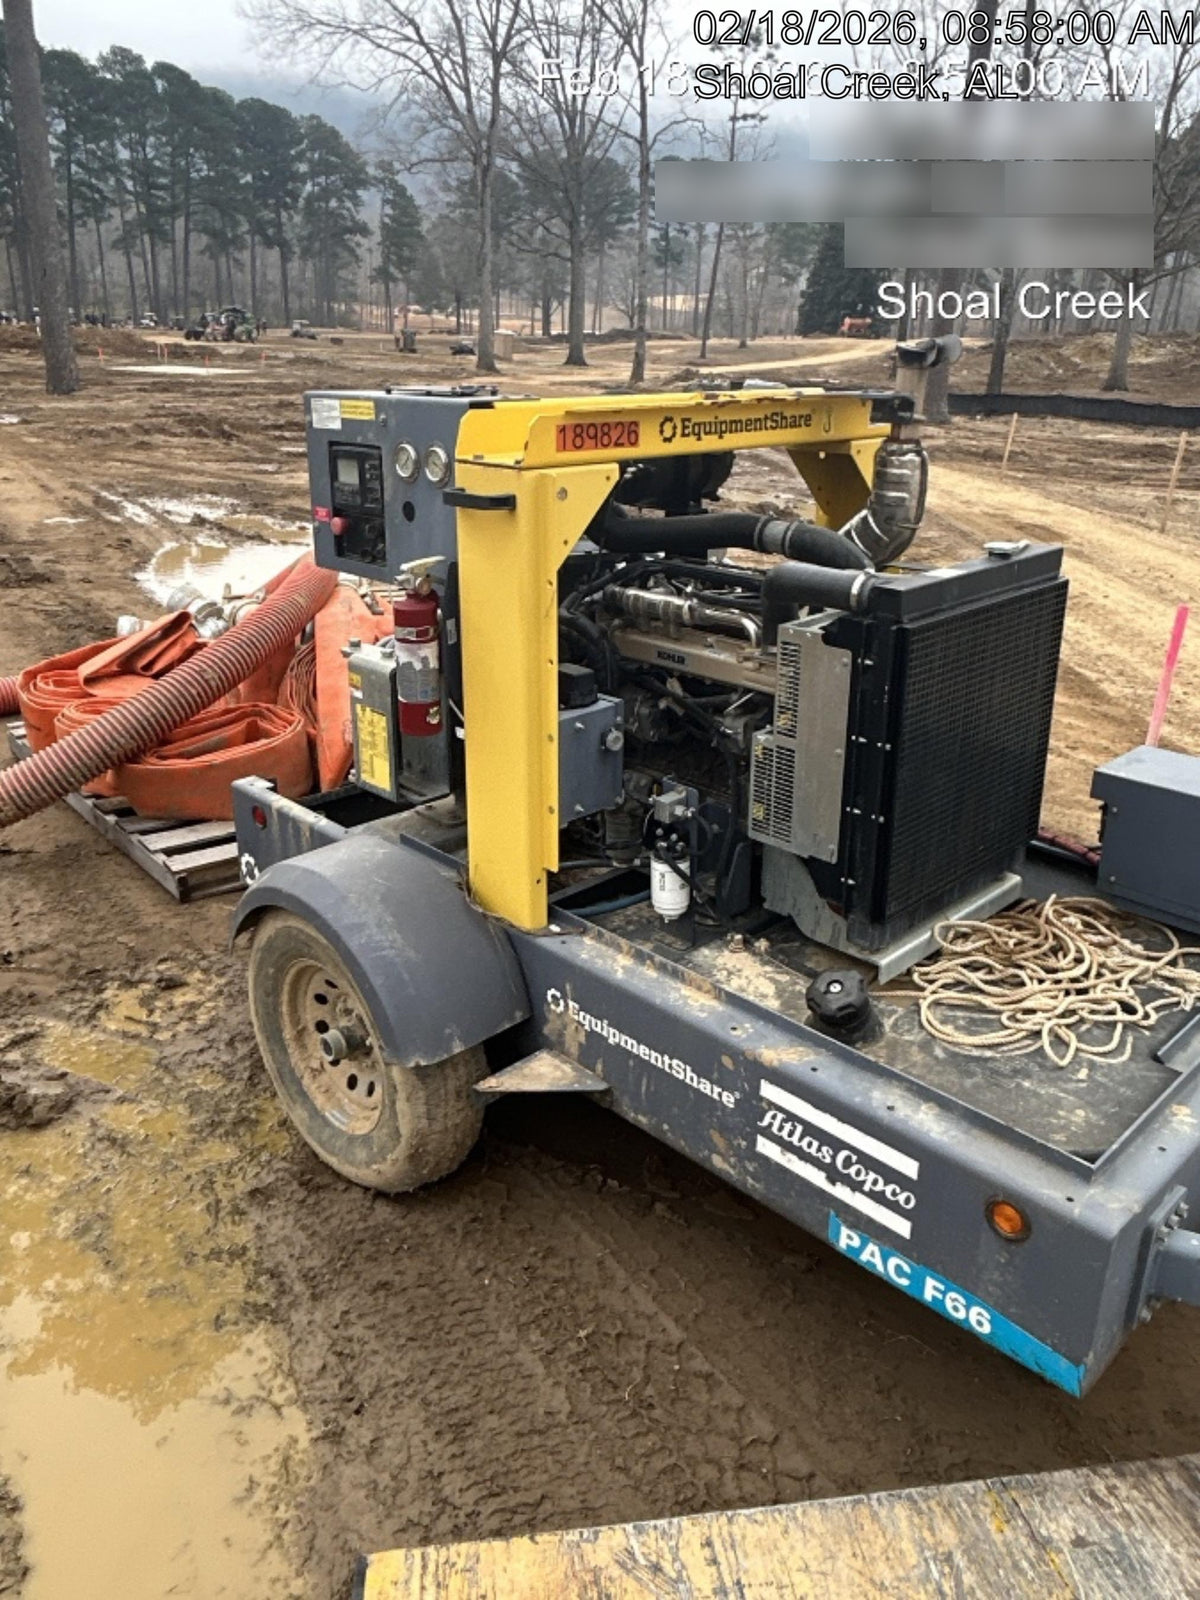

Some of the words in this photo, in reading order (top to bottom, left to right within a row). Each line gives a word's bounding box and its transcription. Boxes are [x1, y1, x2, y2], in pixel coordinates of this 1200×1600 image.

[558, 421, 639, 451] 189826
[680, 411, 813, 441] EquipmentShare
[567, 999, 737, 1109] EquipmentShare
[757, 1109, 834, 1164] Atlas
[835, 1149, 917, 1210] Copco
[838, 1225, 912, 1287] PAC
[923, 1275, 993, 1335] F66
